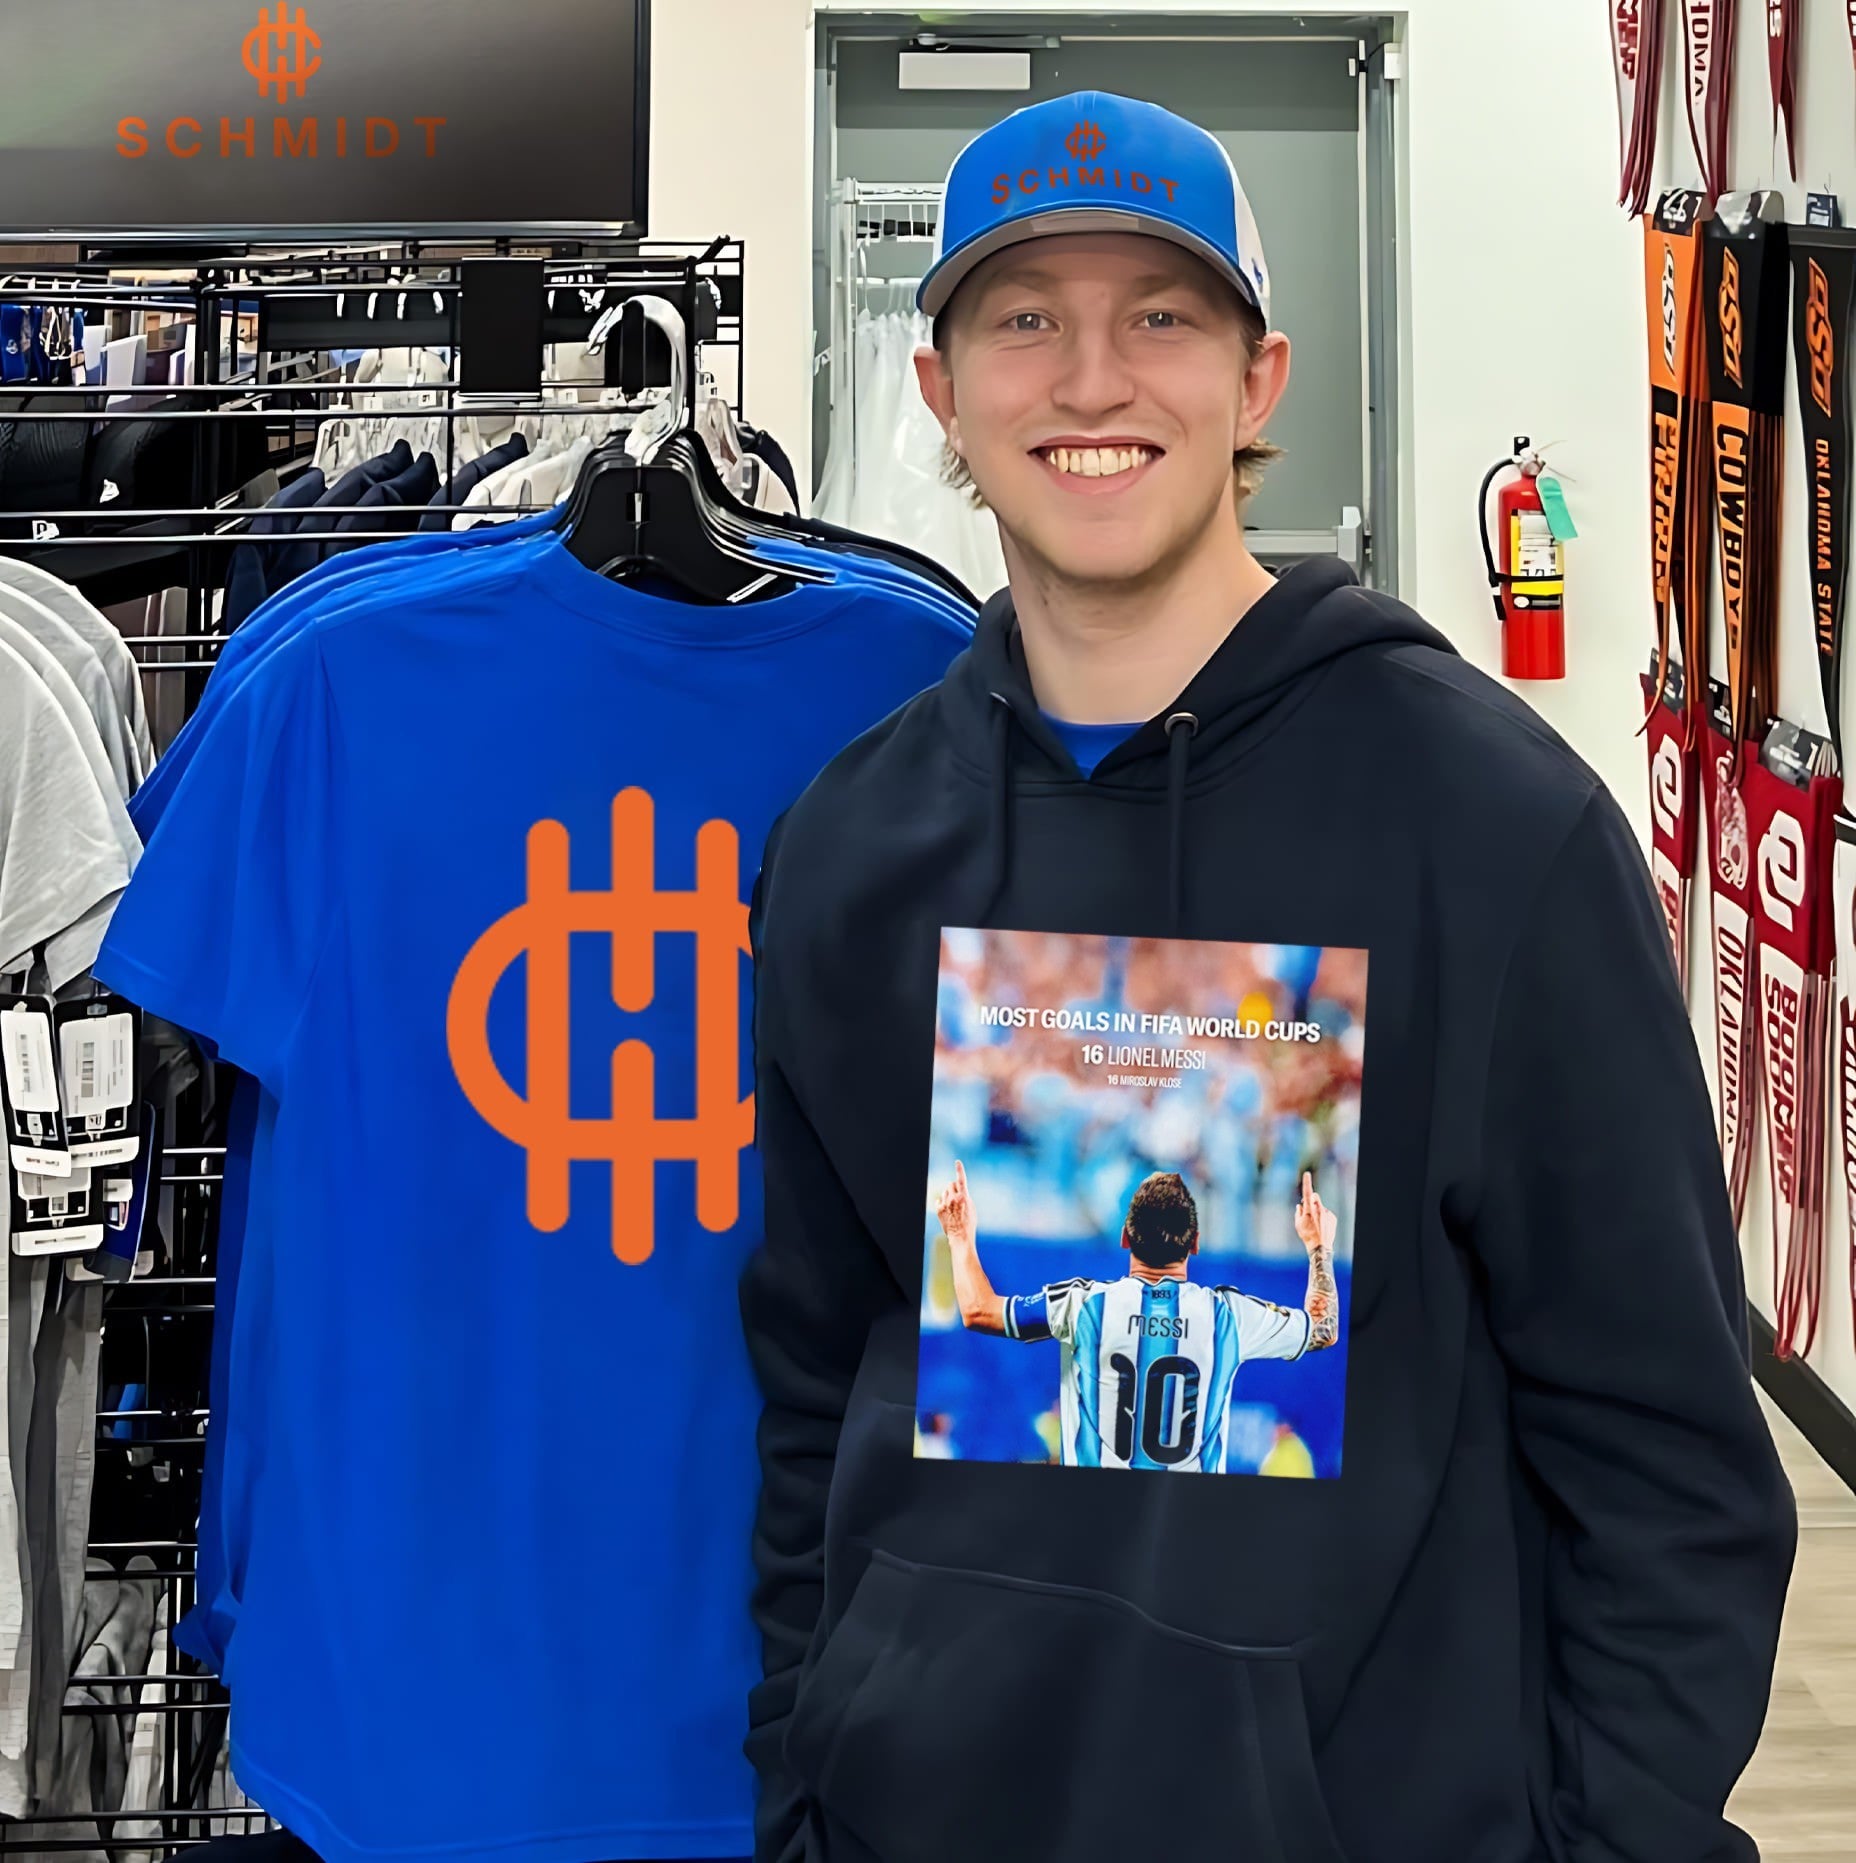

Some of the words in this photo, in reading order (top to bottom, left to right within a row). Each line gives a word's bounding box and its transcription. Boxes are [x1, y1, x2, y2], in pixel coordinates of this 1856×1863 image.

[116, 117, 448, 158] SCHMIDT
[991, 167, 1179, 204] SCHMIDT
[1815, 438, 1832, 570] OKLAHOMA
[980, 1006, 1039, 1027] MOST
[1041, 1009, 1110, 1031] GOALS
[1114, 1013, 1136, 1033] IN
[1141, 1014, 1183, 1035] FIFA
[1186, 1017, 1261, 1039] WORLD
[1264, 1020, 1321, 1043] CUPS
[1081, 1044, 1104, 1065] 16
[1107, 1046, 1160, 1067] LIONEL
[1161, 1049, 1206, 1070] MESSI
[1107, 1074, 1119, 1085] 16
[1120, 1075, 1158, 1087] MIROSLAV
[1159, 1077, 1182, 1089] KLOSE
[1128, 1315, 1189, 1339] MESSI
[1110, 1353, 1200, 1465] 10
